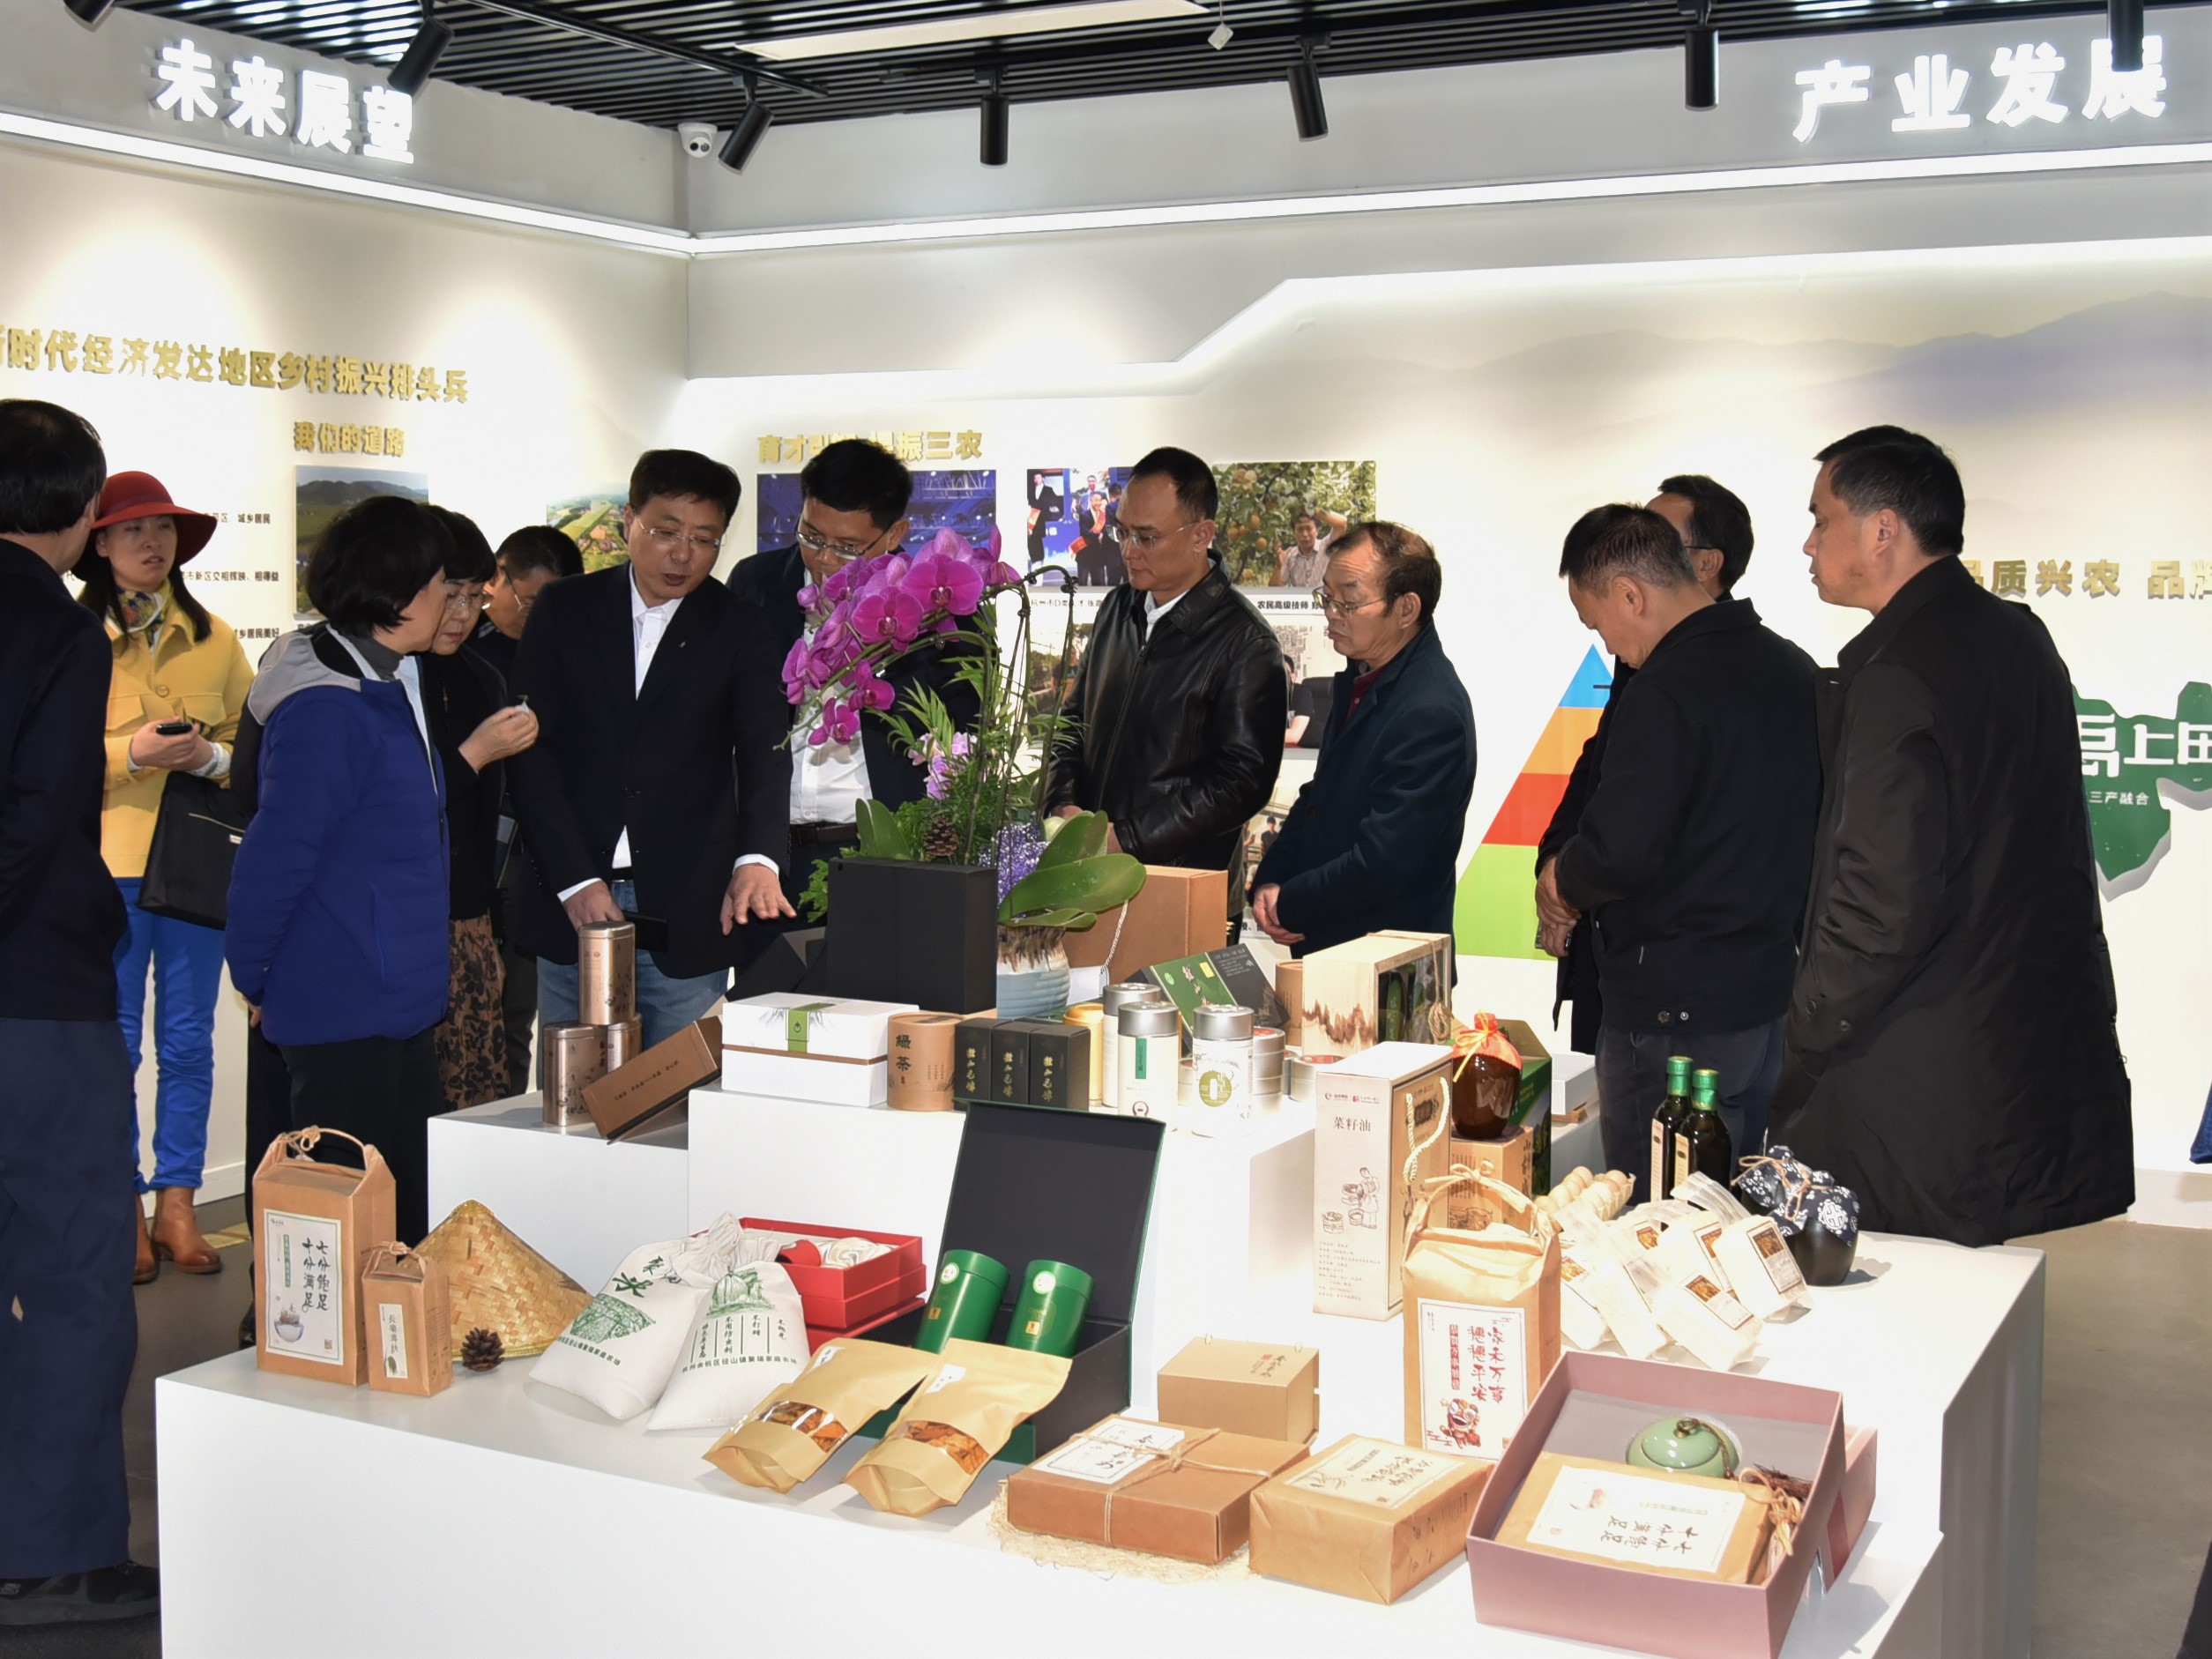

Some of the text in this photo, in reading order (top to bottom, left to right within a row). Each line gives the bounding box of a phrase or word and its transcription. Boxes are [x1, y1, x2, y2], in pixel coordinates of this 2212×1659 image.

[155, 39, 414, 165] 未来展望
[0, 324, 469, 404] 时代经济发达地区乡村振兴排头兵
[293, 420, 406, 458] 我们的道路
[1257, 600, 1308, 610] 农民高级技师
[2089, 791, 2149, 806] 三产融合
[1334, 1116, 1371, 1132] 菜籽油
